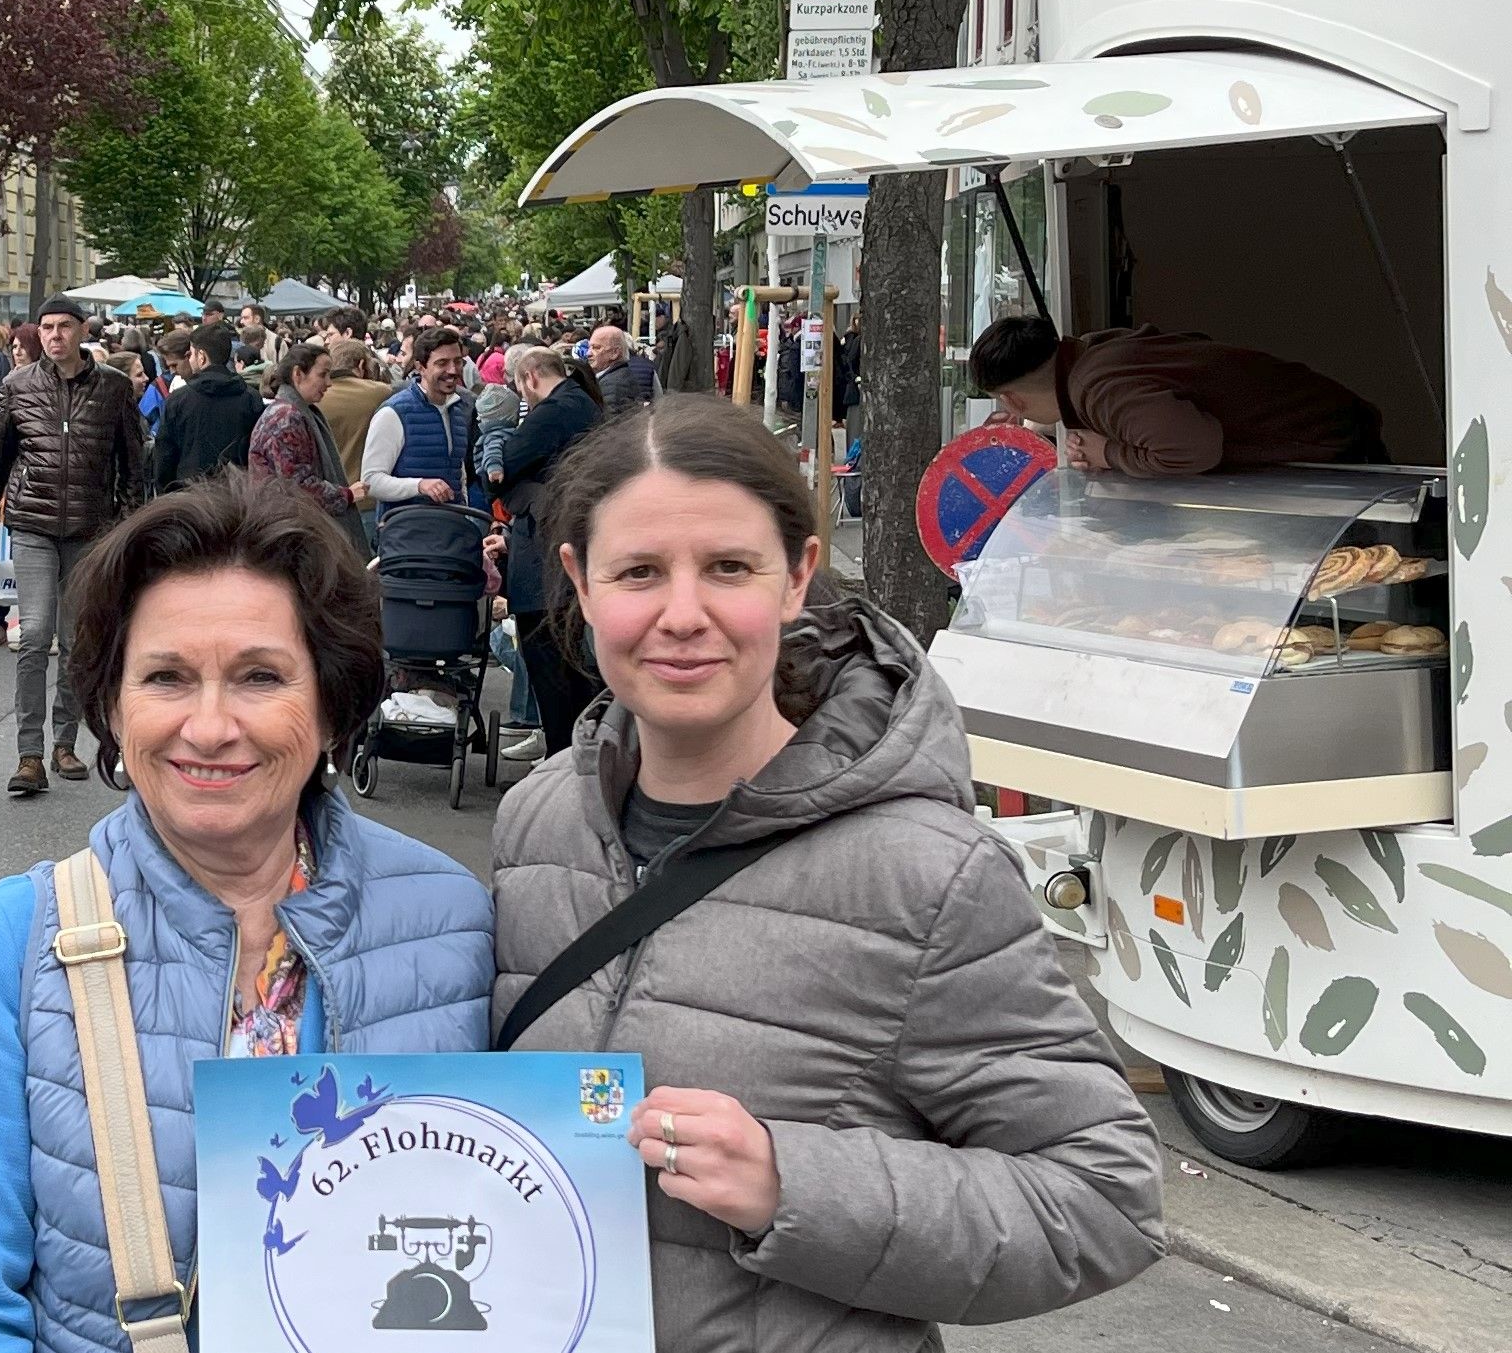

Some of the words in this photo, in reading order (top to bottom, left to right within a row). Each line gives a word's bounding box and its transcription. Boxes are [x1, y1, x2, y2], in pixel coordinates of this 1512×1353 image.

[796, 2, 869, 16] Kurzparkzone
[794, 34, 867, 46] gebührenpflichtig
[852, 48, 867, 57] Std.
[768, 203, 863, 227] Schulwe
[311, 1159, 360, 1197] 62.
[359, 1121, 544, 1204] Flohmarkt
